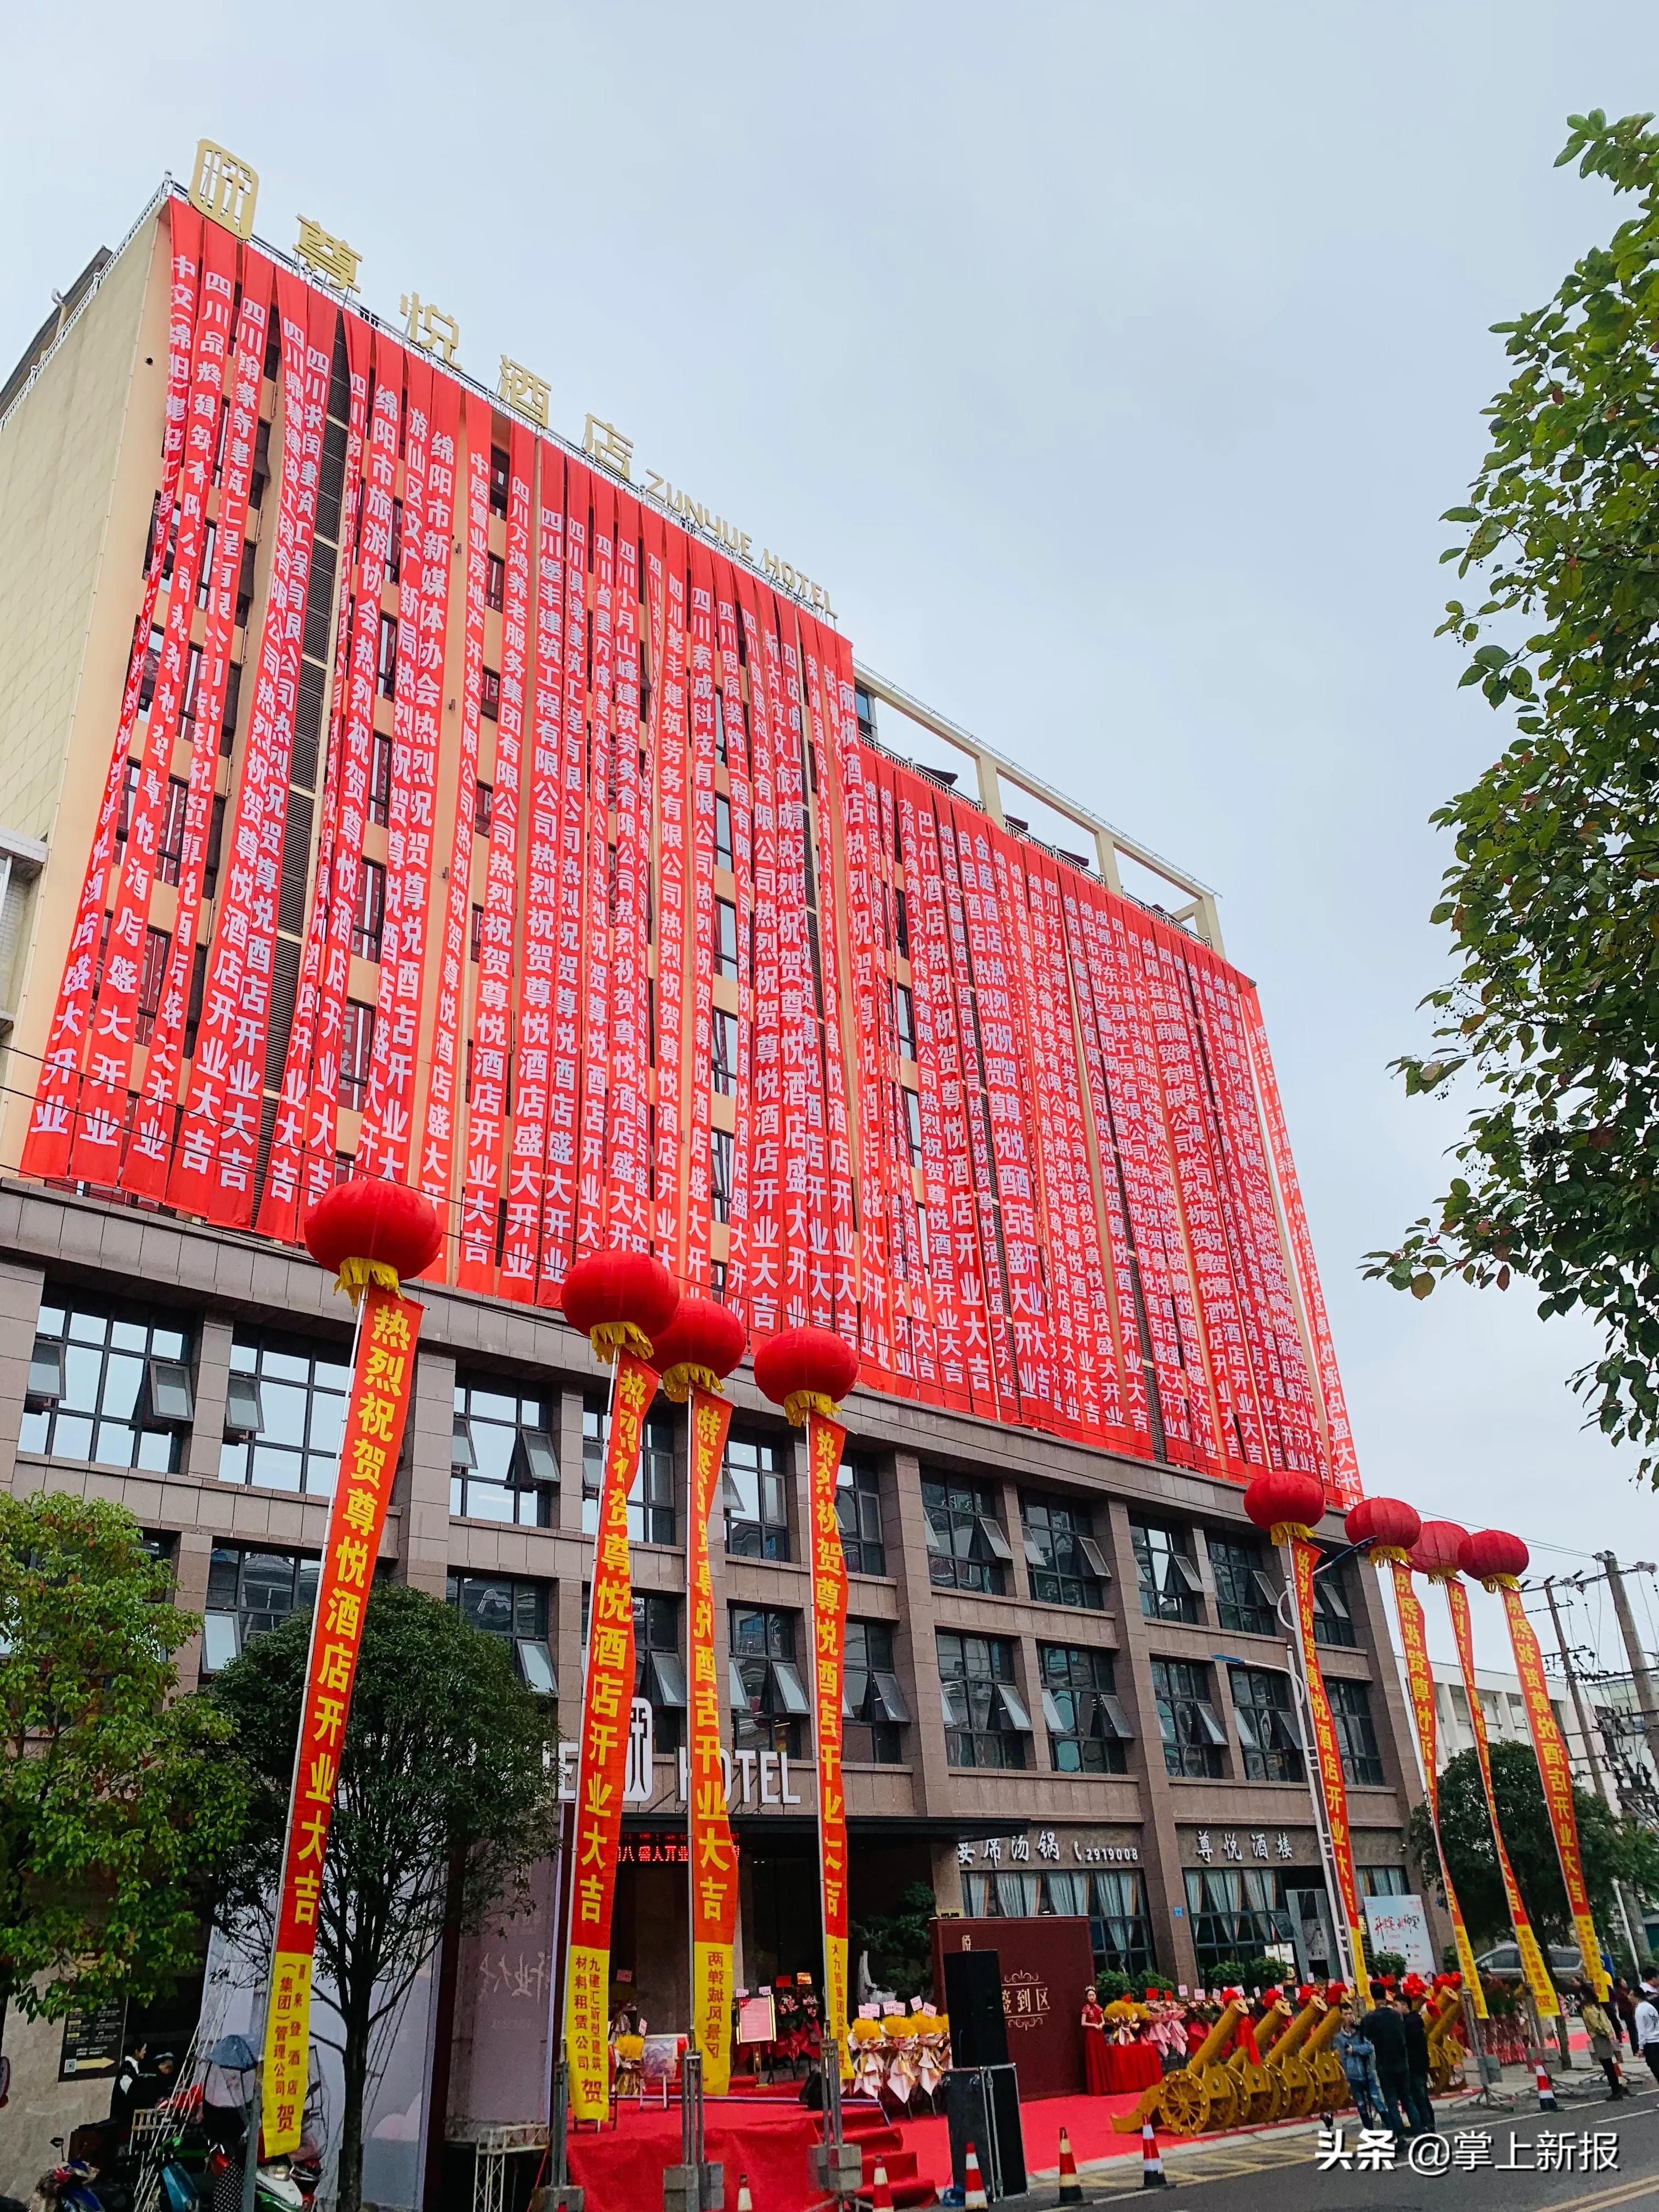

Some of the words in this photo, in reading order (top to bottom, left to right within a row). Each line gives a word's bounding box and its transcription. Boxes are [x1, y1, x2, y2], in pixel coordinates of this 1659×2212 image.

[293, 213, 634, 481] 尊悦酒店
[646, 469, 755, 562] ZUNYUE
[763, 548, 839, 619] HOTEL
[349, 408, 428, 1181] 游仙区文广新局热烈祝贺尊悦酒店盛大开
[373, 431, 453, 1183] 绵阳市新媒体协会热烈祝贺尊悦酒店开业大
[609, 539, 639, 1251] 四川小月山峰建筑劳务有限公司热烈祝贺尊悦酒店盛大开
[656, 574, 683, 1270] 四川聚丰建筑劳务有限公司热烈祝贺尊悦酒店开业大
[295, 1307, 410, 1926] 热烈祝贺尊悦酒店开业大吉
[1086, 1846, 1139, 1861] 2919008
[1197, 1830, 1294, 1864] 尊悦酒楼
[574, 1955, 589, 2071] 材料租赁公司
[582, 2079, 603, 2104] 贺
[276, 2103, 295, 2134] 贺
